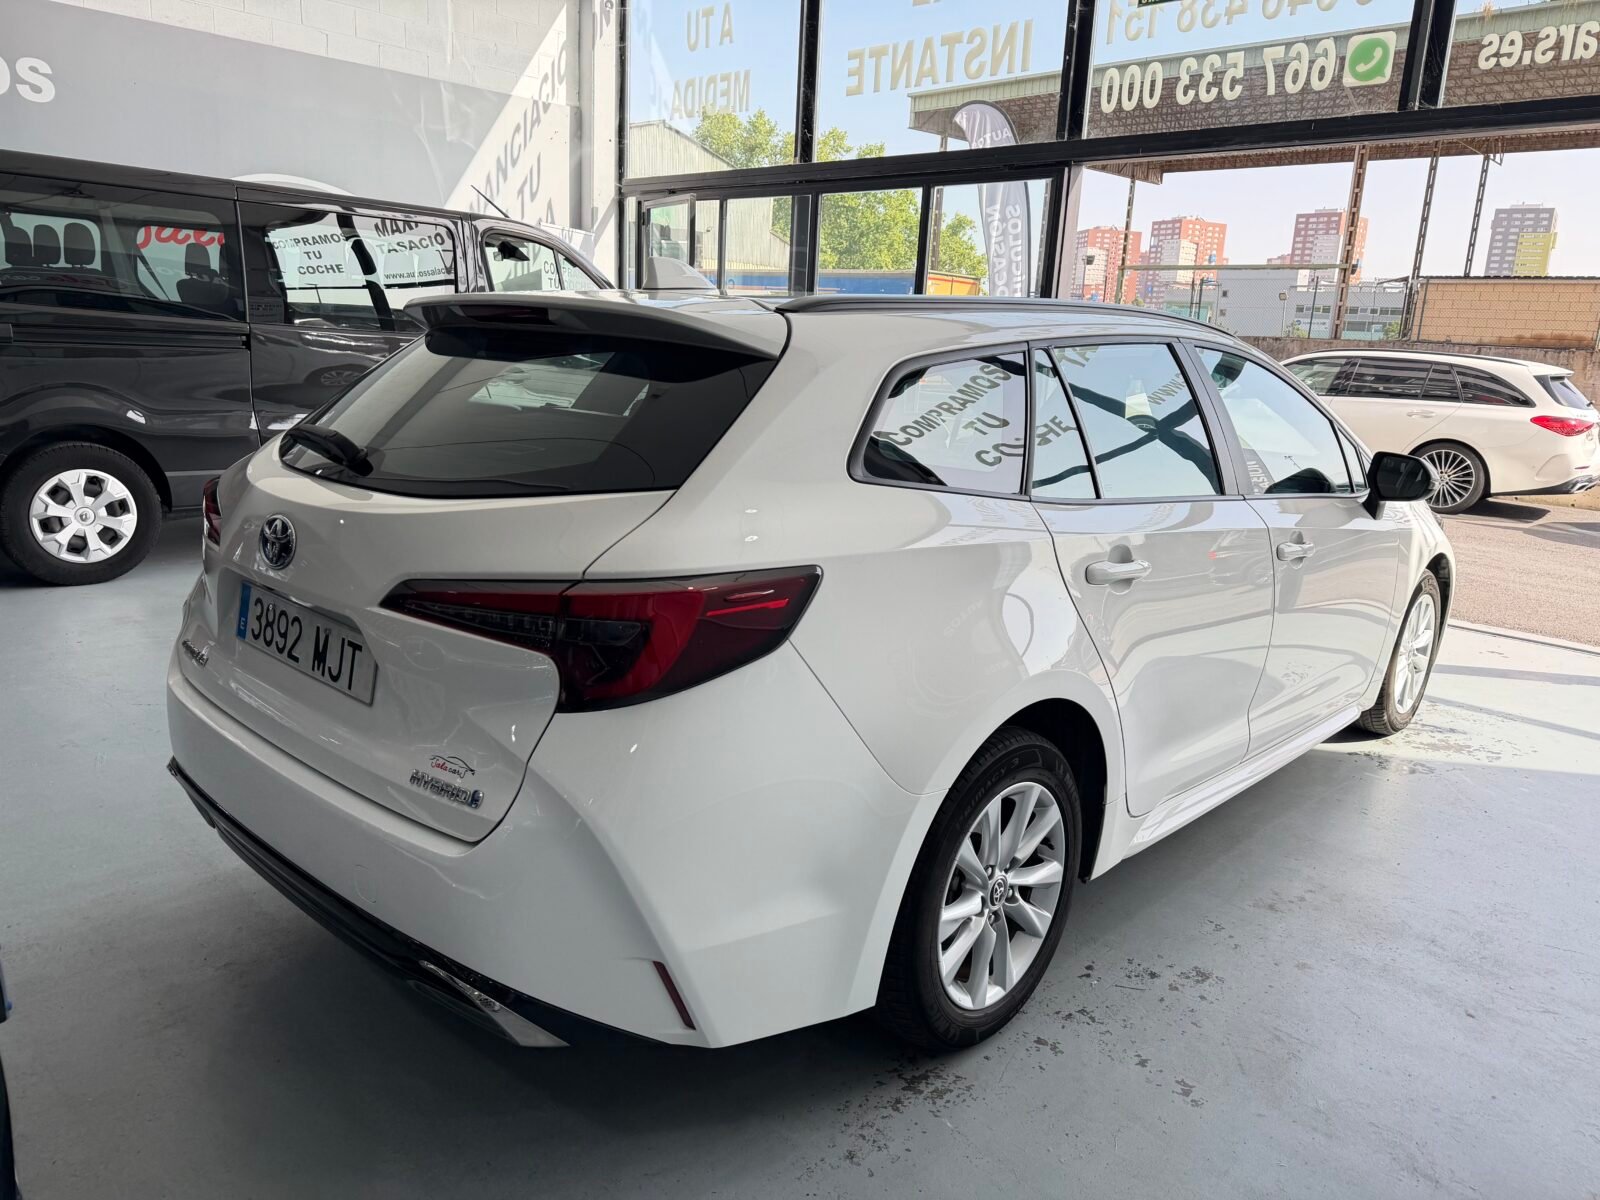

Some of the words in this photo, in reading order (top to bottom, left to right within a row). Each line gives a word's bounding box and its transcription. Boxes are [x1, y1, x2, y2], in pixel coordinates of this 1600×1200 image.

[303, 251, 323, 261] TU
[297, 263, 345, 276] COCHE
[963, 411, 1010, 436] TU
[251, 597, 303, 664] 3892
[312, 625, 363, 691] MJT
